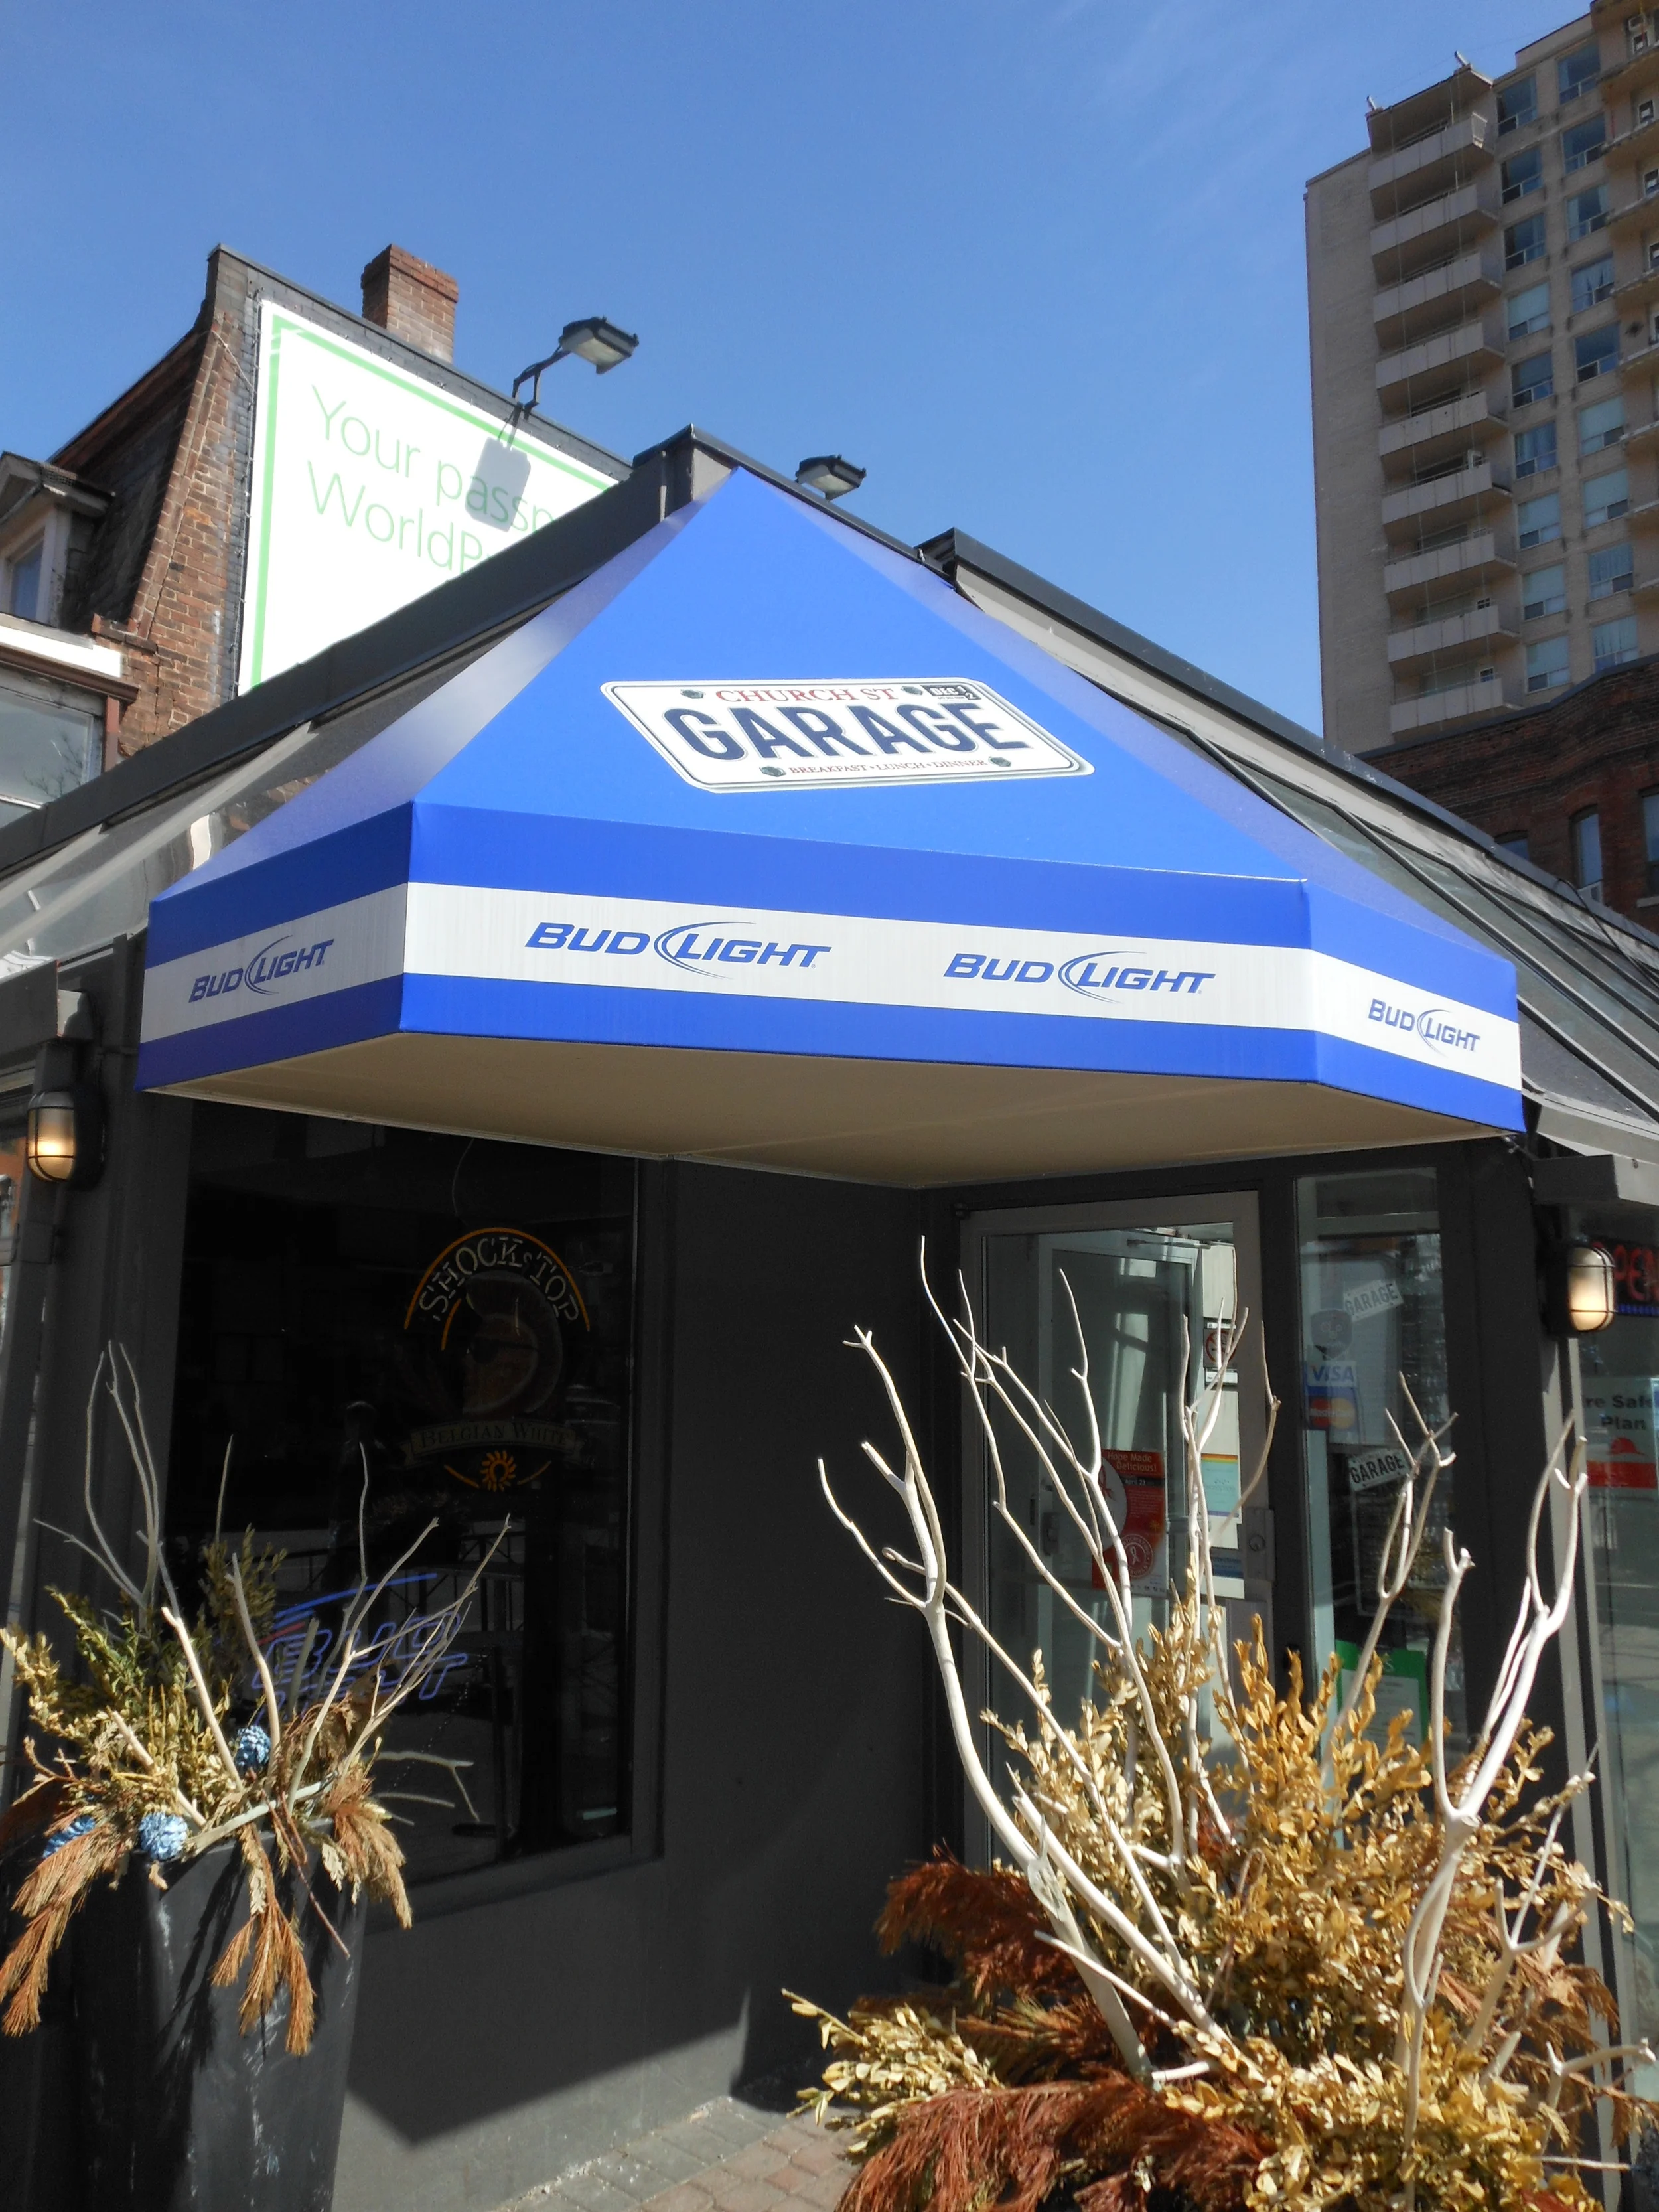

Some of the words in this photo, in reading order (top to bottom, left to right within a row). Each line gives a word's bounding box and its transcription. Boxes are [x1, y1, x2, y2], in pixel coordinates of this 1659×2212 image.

[311, 384, 421, 478] Your
[307, 459, 492, 573] WorldP
[715, 688, 861, 702] CHURCH
[862, 688, 899, 700] ST
[929, 687, 960, 696] DEC
[663, 703, 1032, 761] GARAGE
[524, 922, 651, 956] BUD
[674, 932, 833, 969] LIGHT
[189, 967, 244, 1003] BUD
[253, 938, 334, 985] LIGHT
[944, 952, 1054, 984] BUD
[1077, 961, 1216, 994] LIGHT
[1368, 999, 1416, 1032] BUD
[1424, 1017, 1481, 1052] LIGHT
[419, 1236, 524, 1321] SHOCK
[529, 1252, 579, 1321] TOP
[1585, 1242, 1659, 1307] PEN
[1345, 1284, 1398, 1315] GARAGE
[1312, 1365, 1354, 1382] VISA
[420, 1424, 504, 1449] BELGIAN
[511, 1421, 569, 1445] WHITE
[1601, 1415, 1646, 1430] Plan
[1108, 1452, 1128, 1463] Hope
[1131, 1454, 1152, 1463] Made
[1116, 1462, 1157, 1472] Delicious!
[1349, 1455, 1405, 1484] GARAGE
